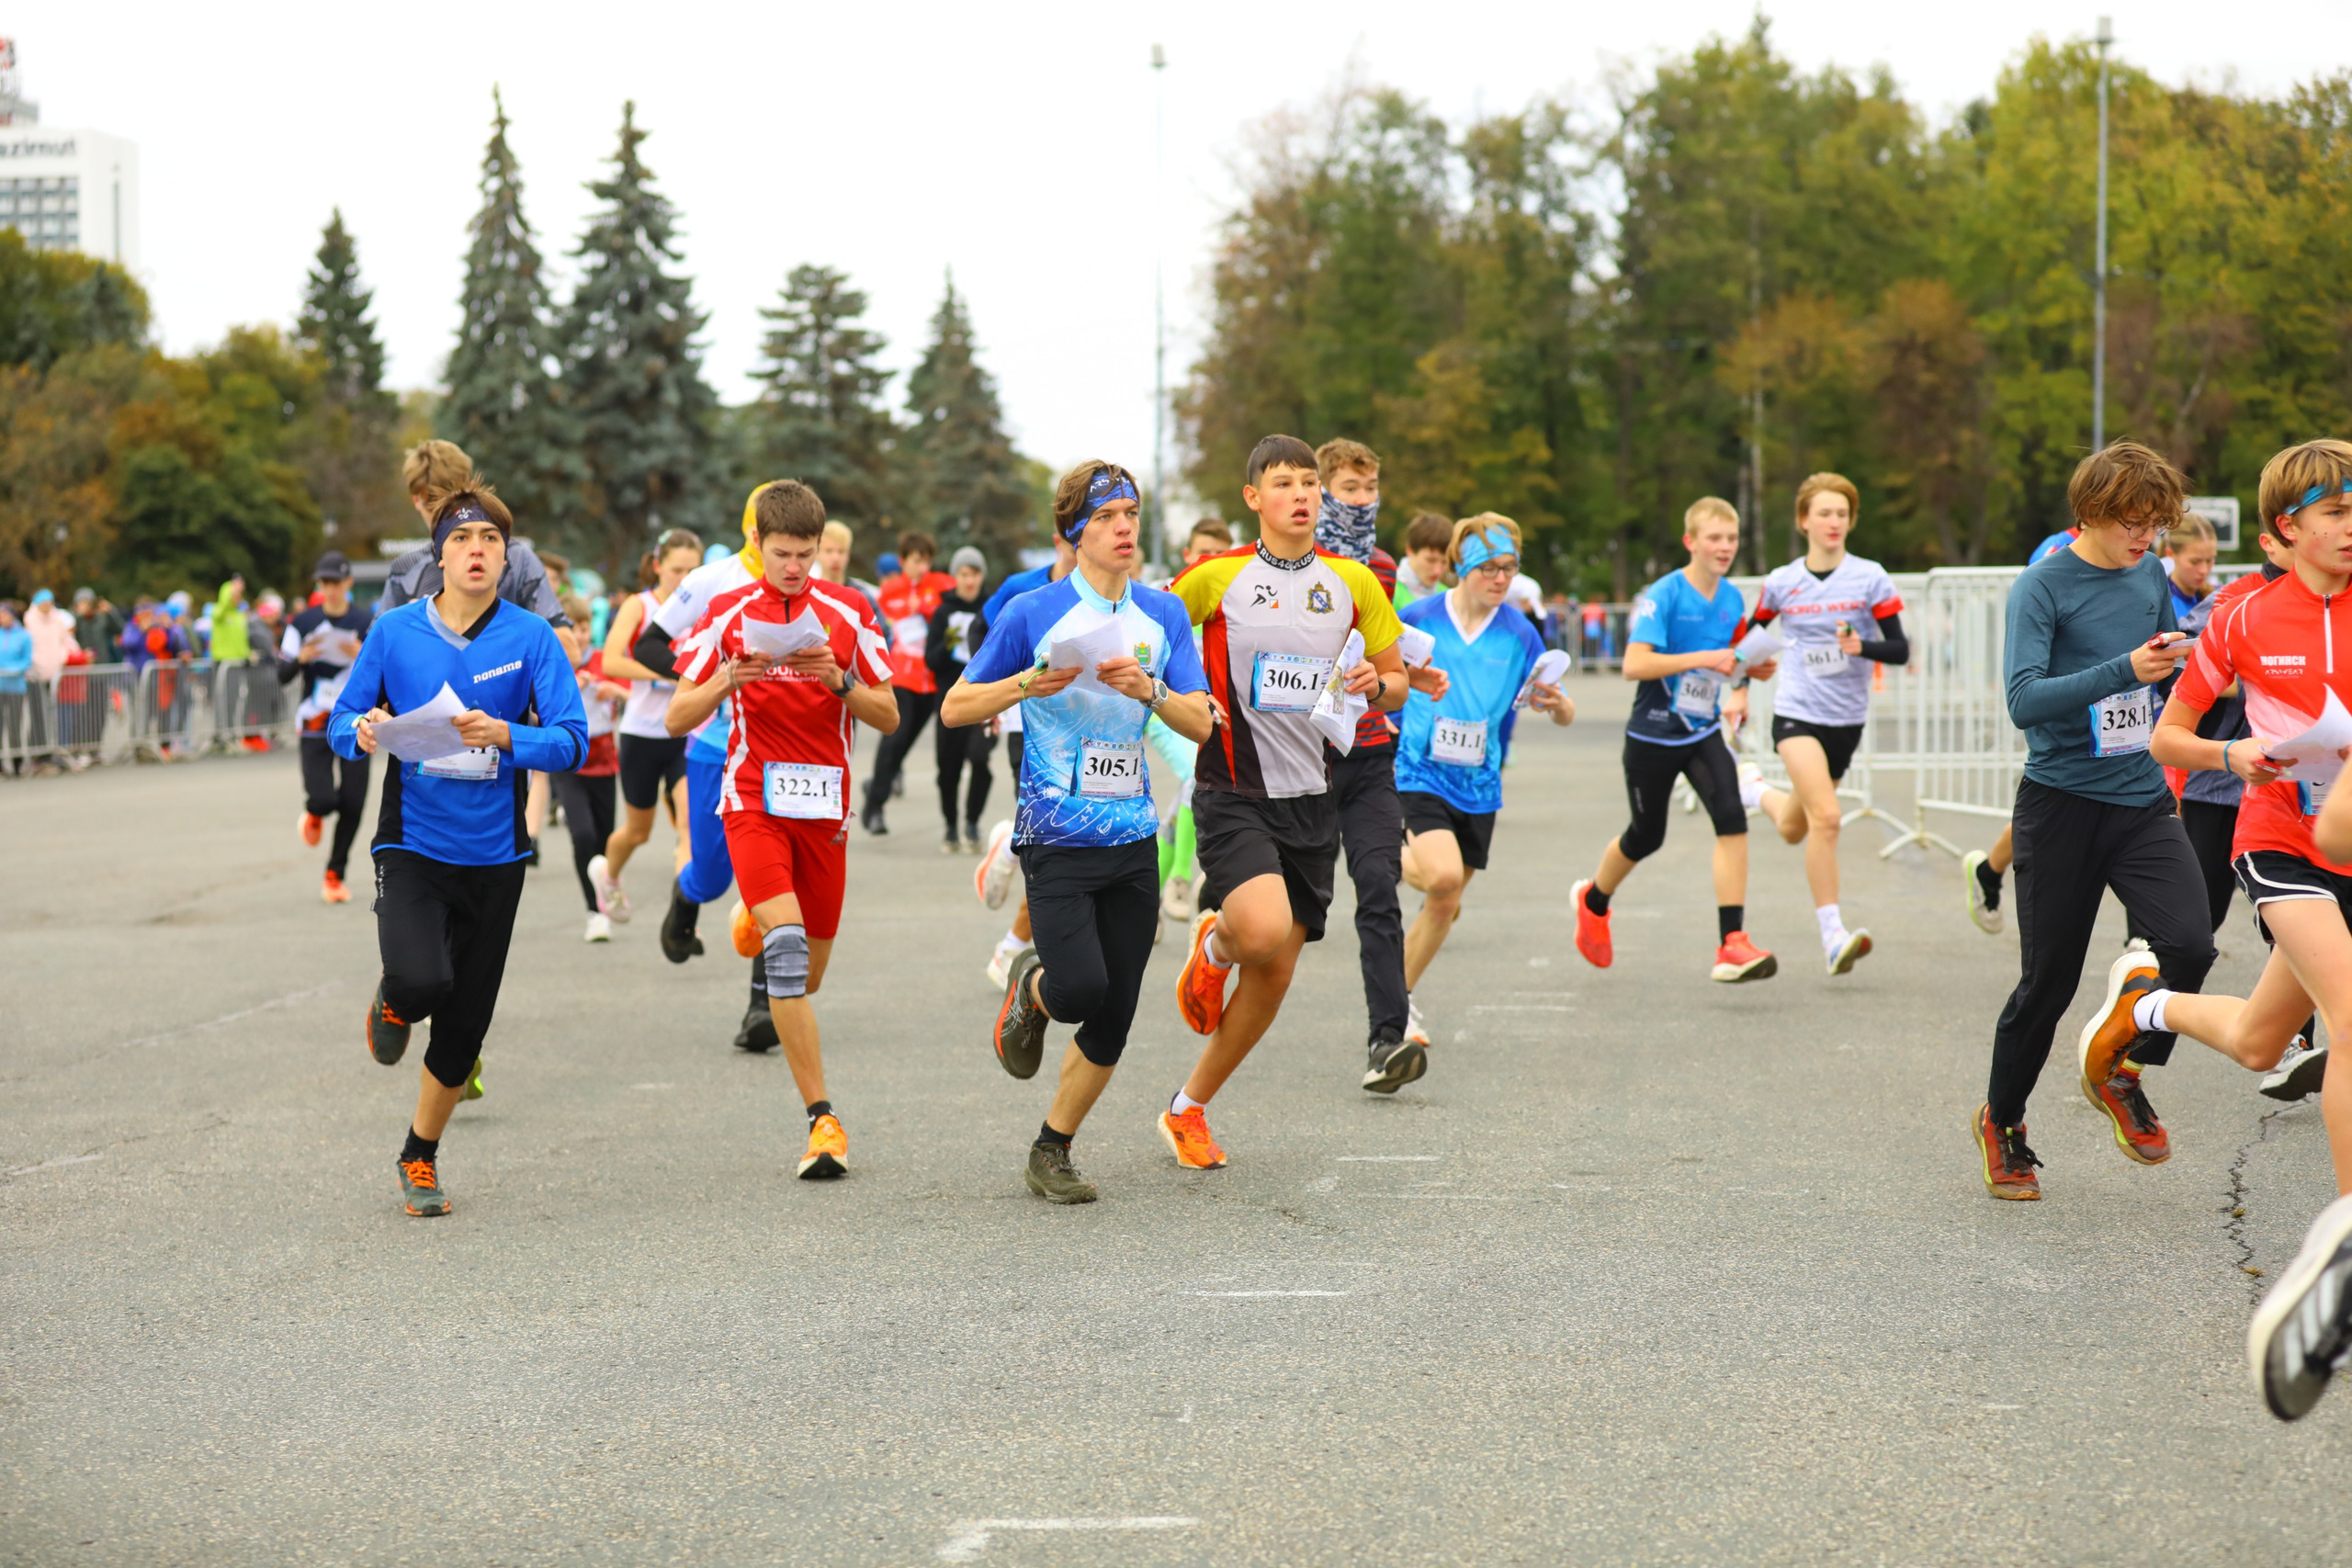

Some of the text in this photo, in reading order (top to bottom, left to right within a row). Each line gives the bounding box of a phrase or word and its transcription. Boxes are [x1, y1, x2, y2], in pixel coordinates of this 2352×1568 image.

[473, 660, 522, 684] noname
[1263, 669, 1318, 690] 306.1
[2102, 704, 2147, 731] 328.1
[1436, 728, 1480, 749] 331.1
[1084, 757, 1138, 777] 305.1
[775, 777, 828, 797] 322.1
